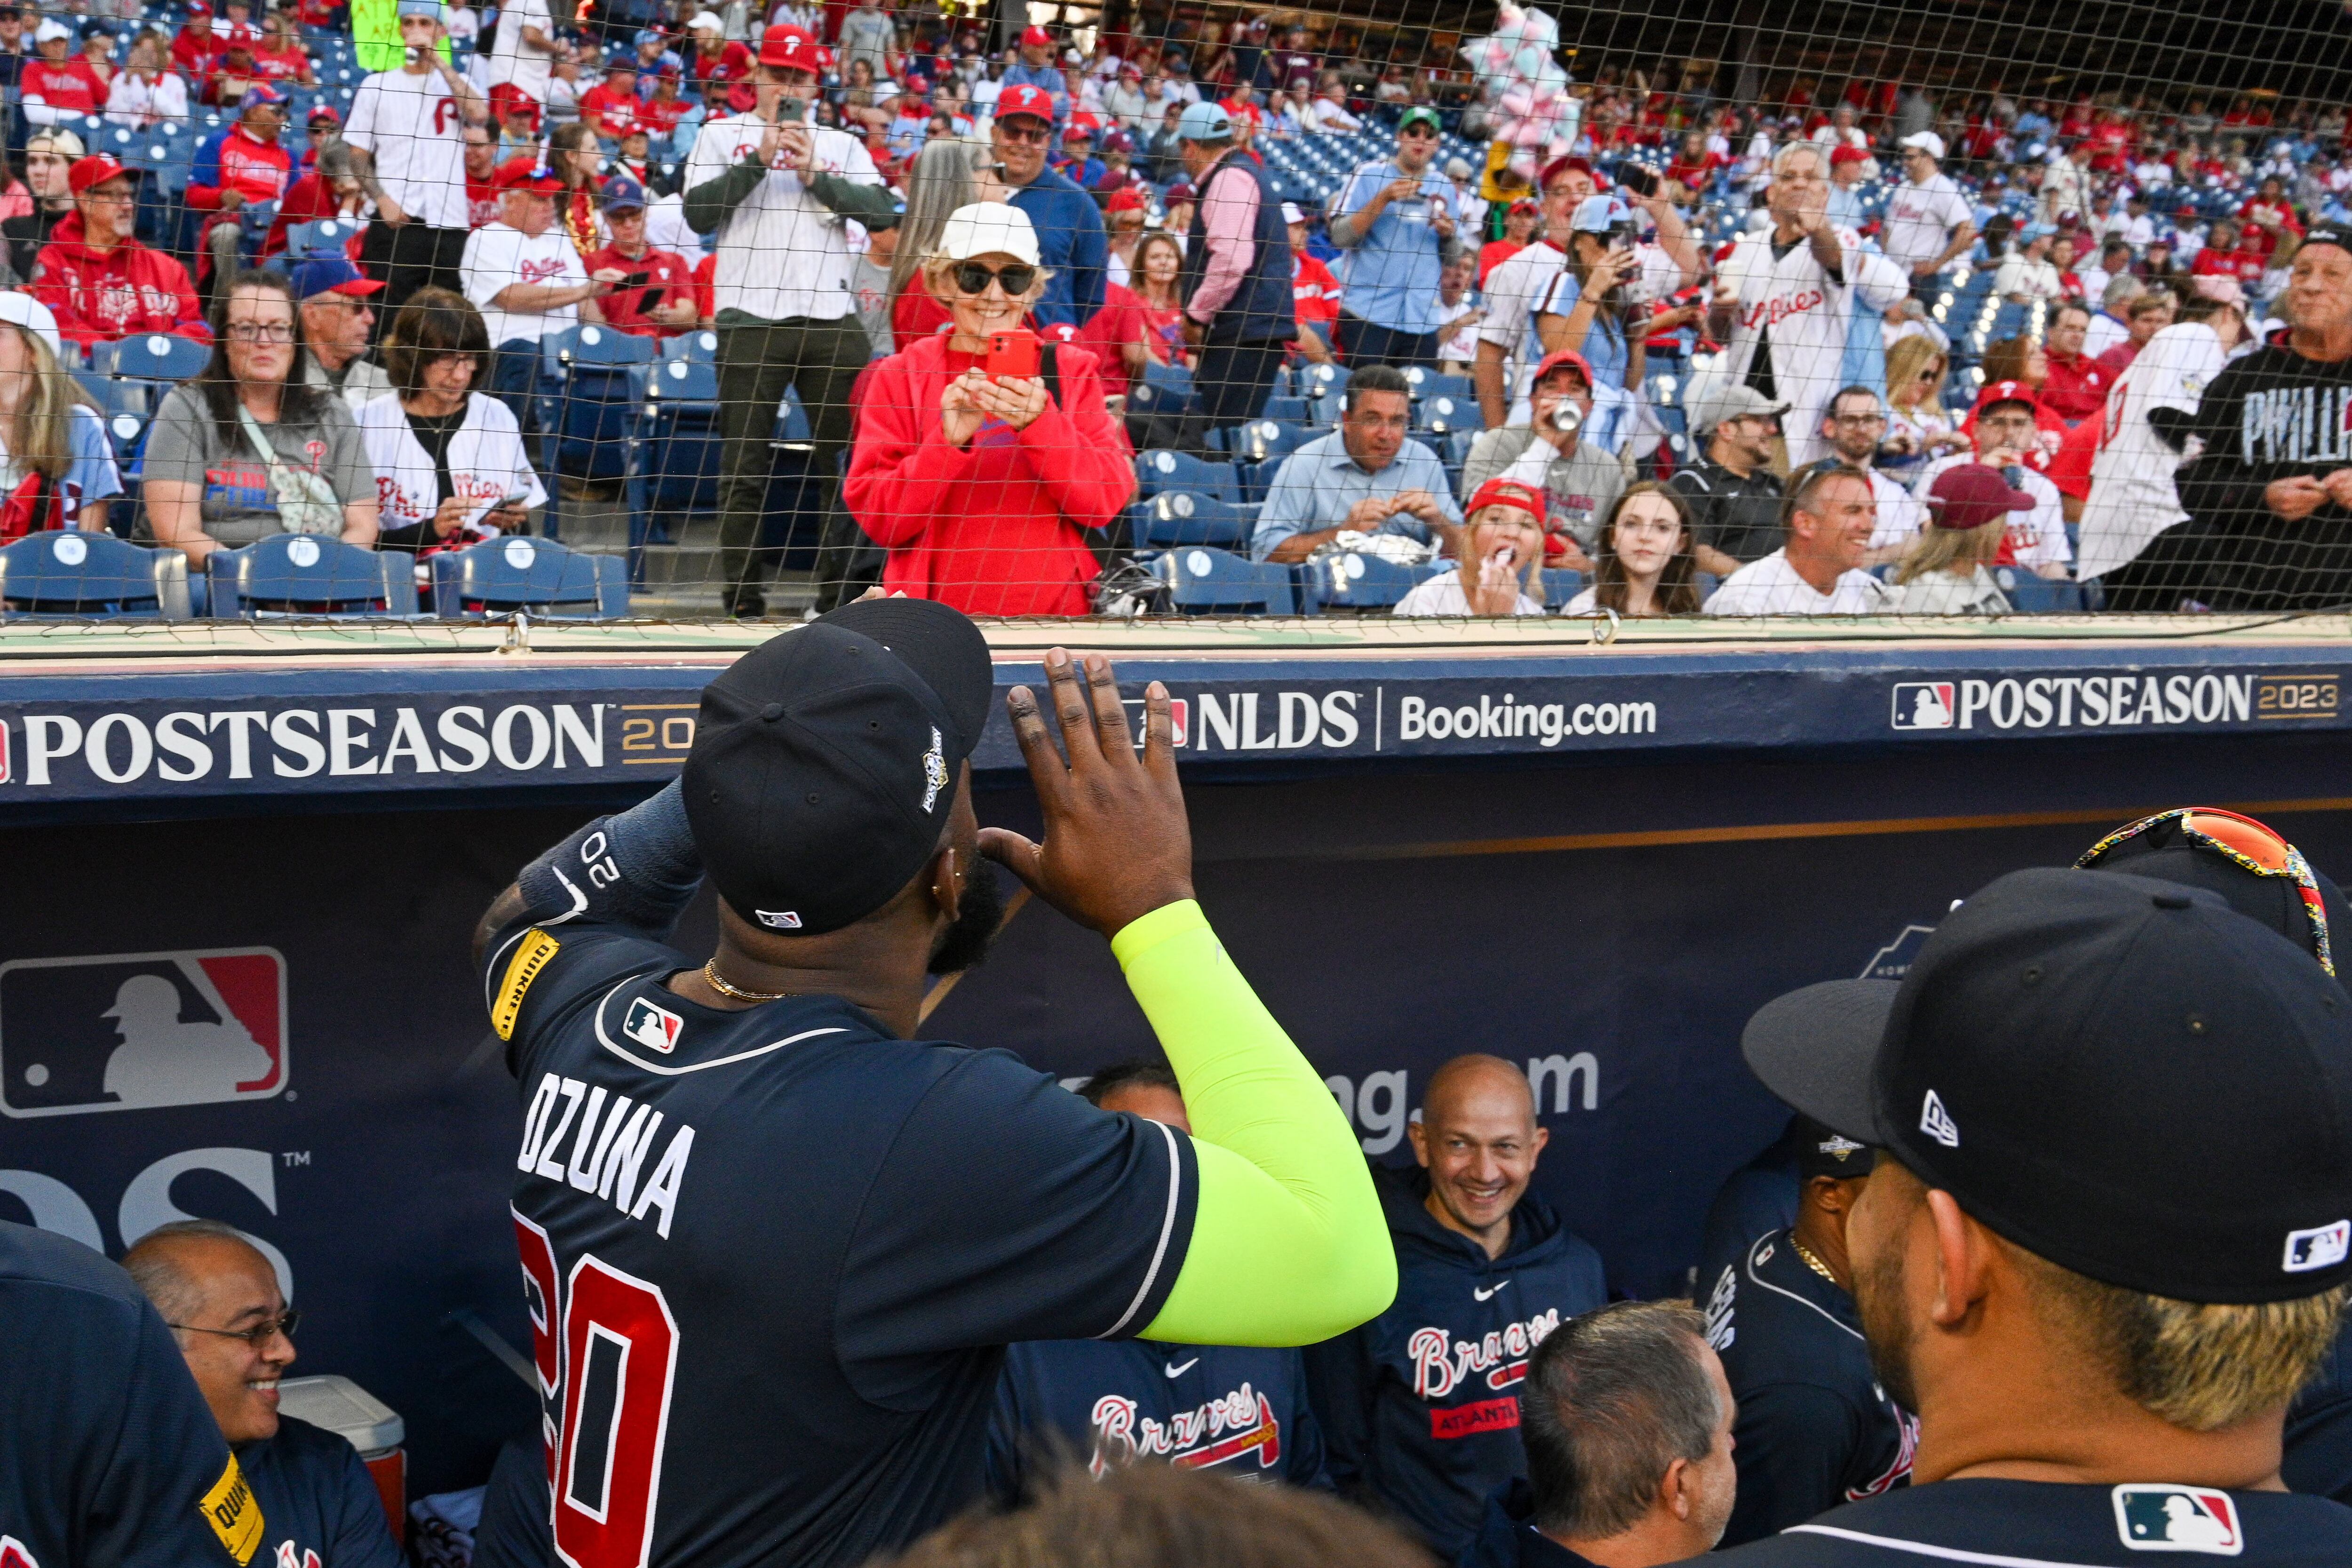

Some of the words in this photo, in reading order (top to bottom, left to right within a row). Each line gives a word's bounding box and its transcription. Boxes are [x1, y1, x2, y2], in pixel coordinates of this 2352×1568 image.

[1197, 690, 1359, 751] NLDS
[1400, 693, 1656, 747] Booking.com
[1959, 675, 2252, 729] POSTSEASON
[2259, 685, 2338, 709] 2023
[23, 703, 607, 786] POSTSEASON
[622, 717, 696, 750] 20
[517, 1072, 696, 1241] OZUNA
[1089, 1382, 1258, 1482] Braves
